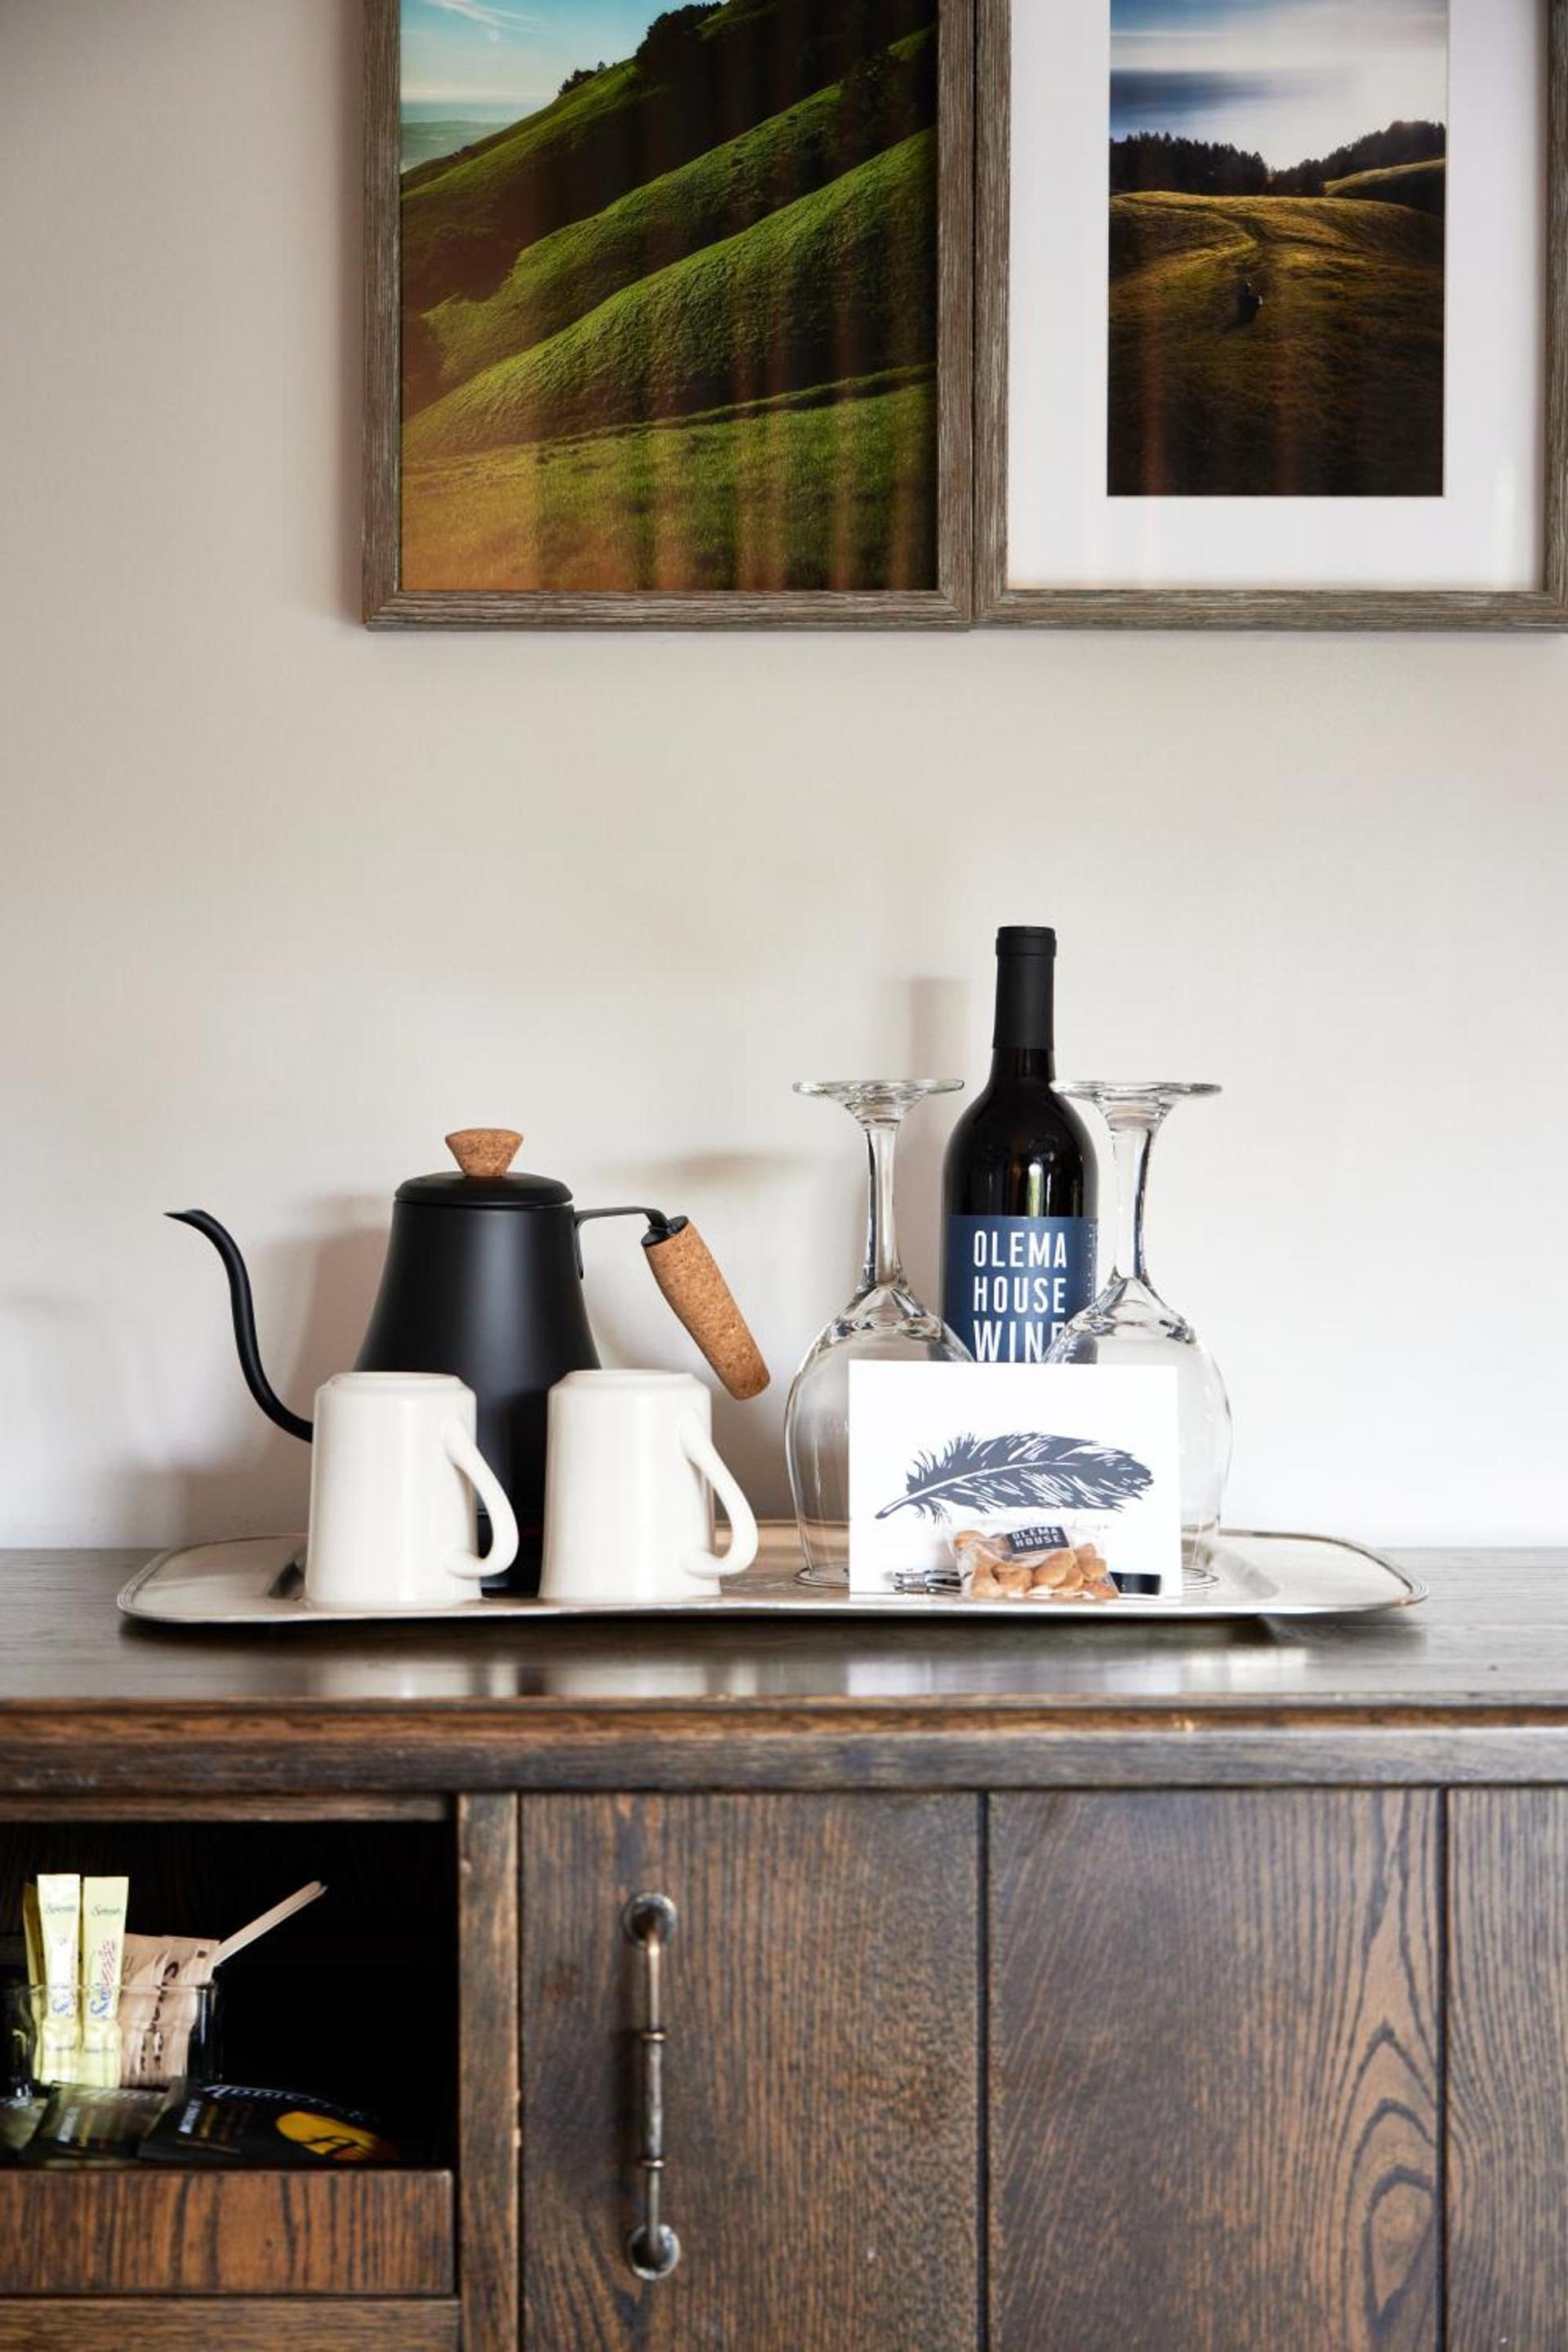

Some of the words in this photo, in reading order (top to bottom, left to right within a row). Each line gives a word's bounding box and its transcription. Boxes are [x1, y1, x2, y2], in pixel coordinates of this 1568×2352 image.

[973, 1231, 1067, 1267] OLEMA
[973, 1276, 1067, 1313] HOUSE
[1015, 1535, 1062, 1548] HOUSE
